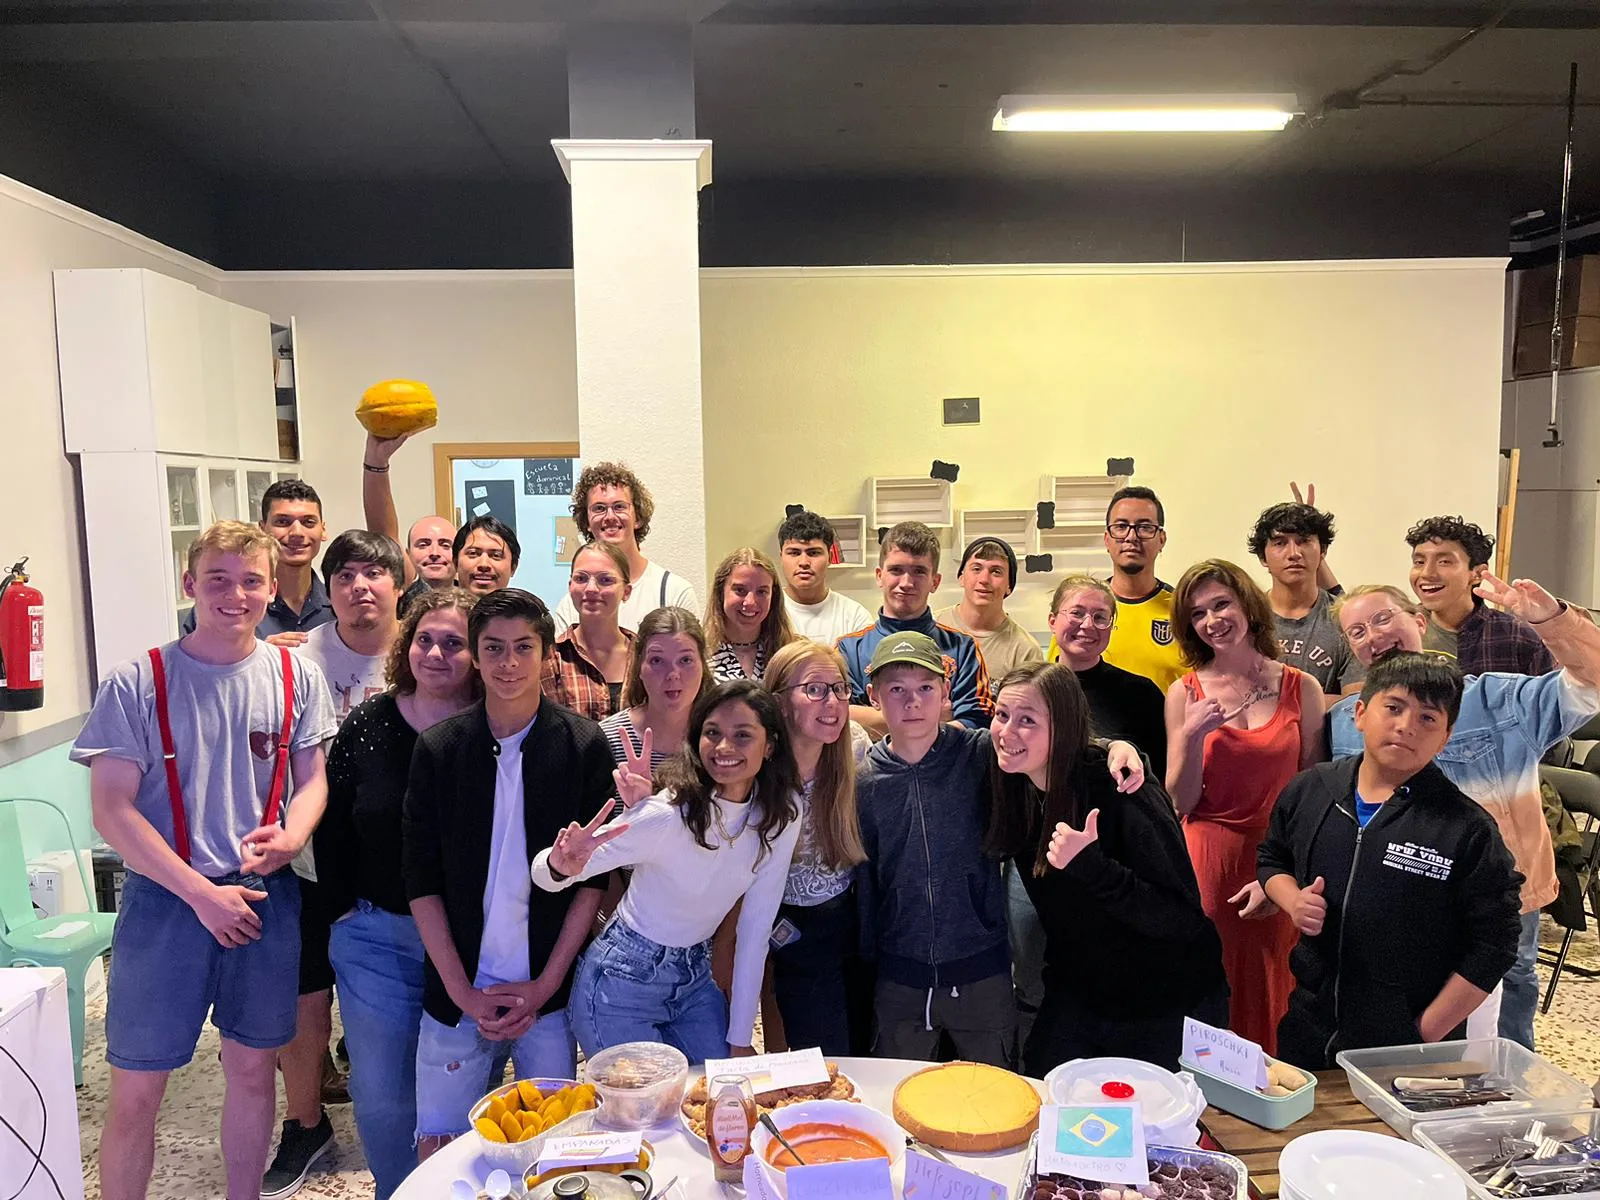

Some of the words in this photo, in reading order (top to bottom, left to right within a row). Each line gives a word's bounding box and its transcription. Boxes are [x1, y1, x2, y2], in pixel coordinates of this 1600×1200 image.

[525, 463, 559, 480] Escuela
[536, 474, 571, 483] dominical
[1308, 645, 1333, 667] UP
[1190, 1024, 1249, 1059] PIROSCHKI
